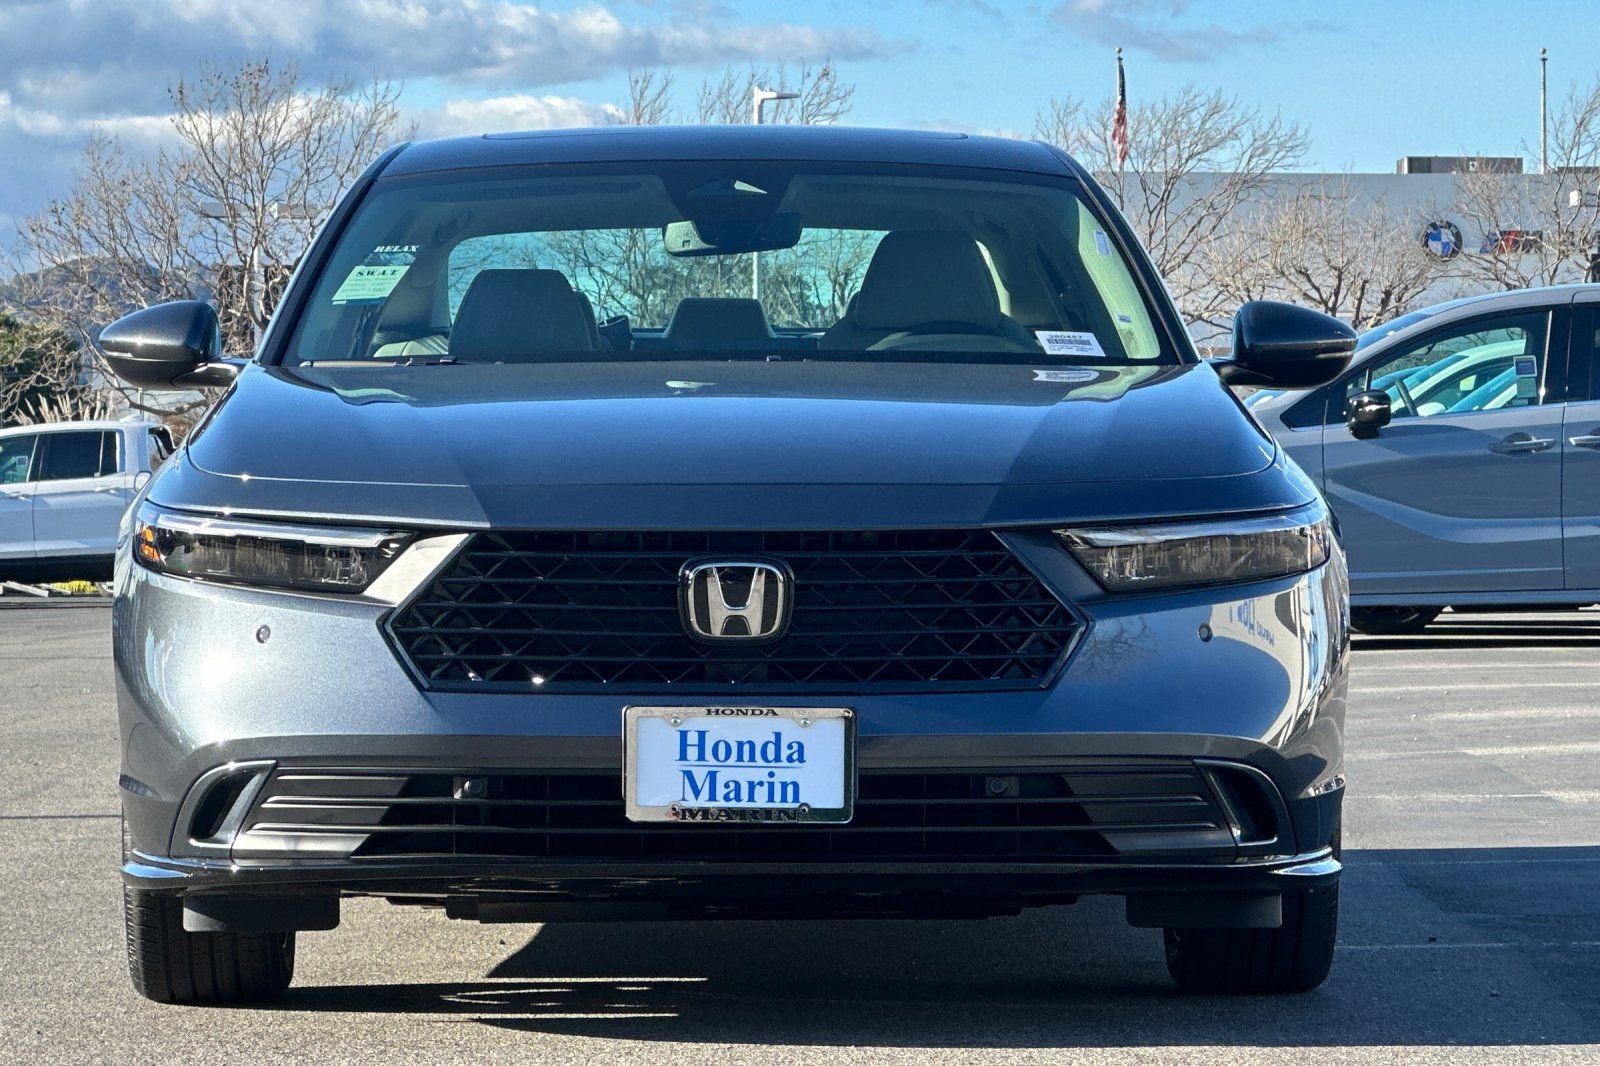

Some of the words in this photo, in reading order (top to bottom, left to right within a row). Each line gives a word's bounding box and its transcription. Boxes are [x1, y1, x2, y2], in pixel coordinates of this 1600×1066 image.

[374, 245, 420, 253] RELAX
[705, 708, 779, 717] HONDA
[675, 729, 807, 764] Honda
[678, 769, 802, 804] Marin
[679, 807, 798, 821] MARIN
